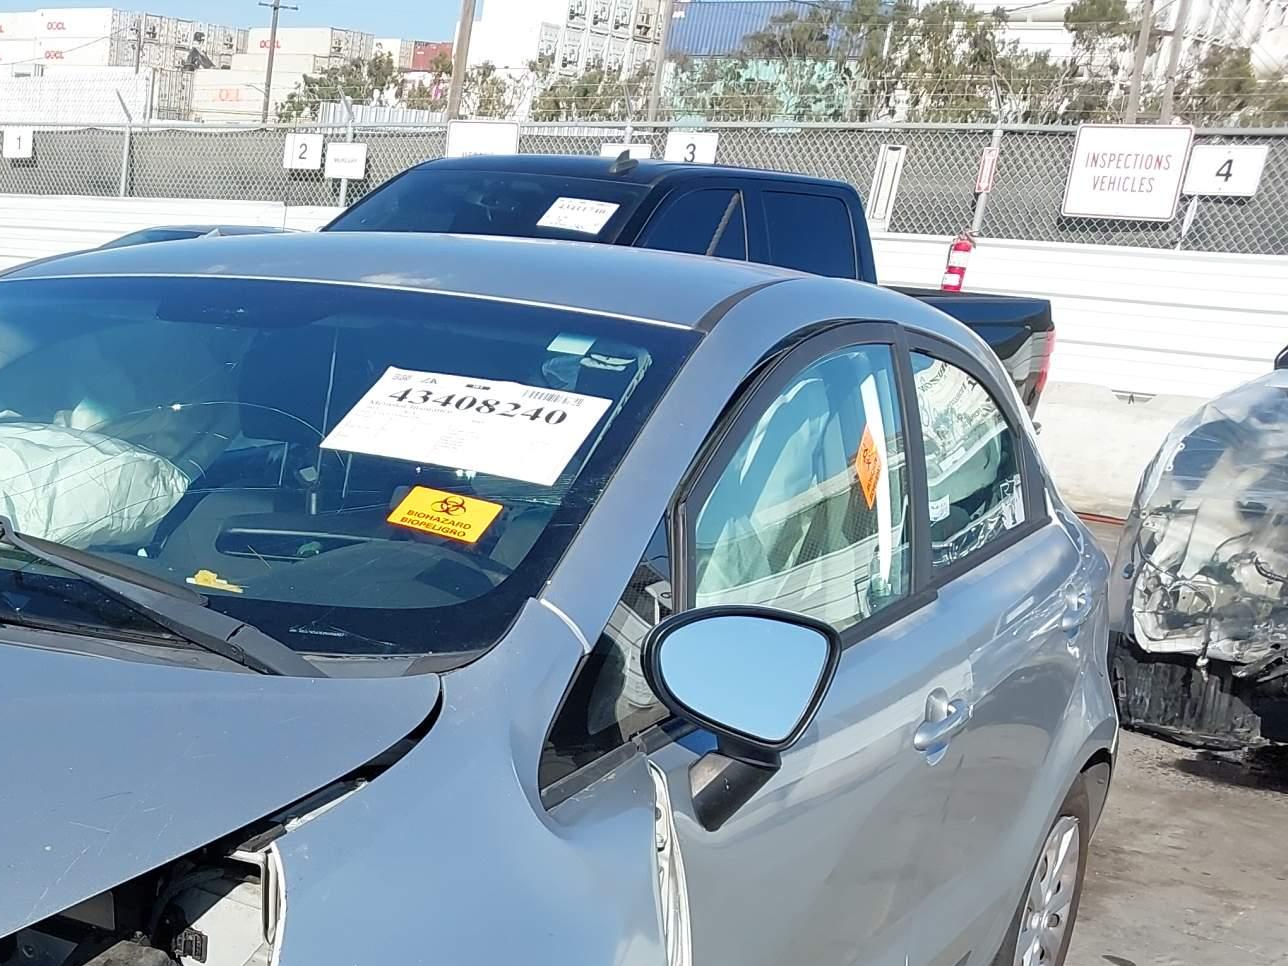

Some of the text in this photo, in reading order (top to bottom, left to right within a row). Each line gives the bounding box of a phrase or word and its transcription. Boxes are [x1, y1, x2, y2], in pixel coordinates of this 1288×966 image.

[298, 143, 308, 160] 2
[684, 143, 697, 162] 3
[1085, 152, 1172, 170] INSPECTIONS
[1215, 159, 1234, 182] 4
[1092, 176, 1155, 193] VEHICLES
[388, 387, 568, 425] 43408240
[399, 516, 466, 538] BIOPELIGRO
[406, 509, 472, 530] BIOHAZARD
